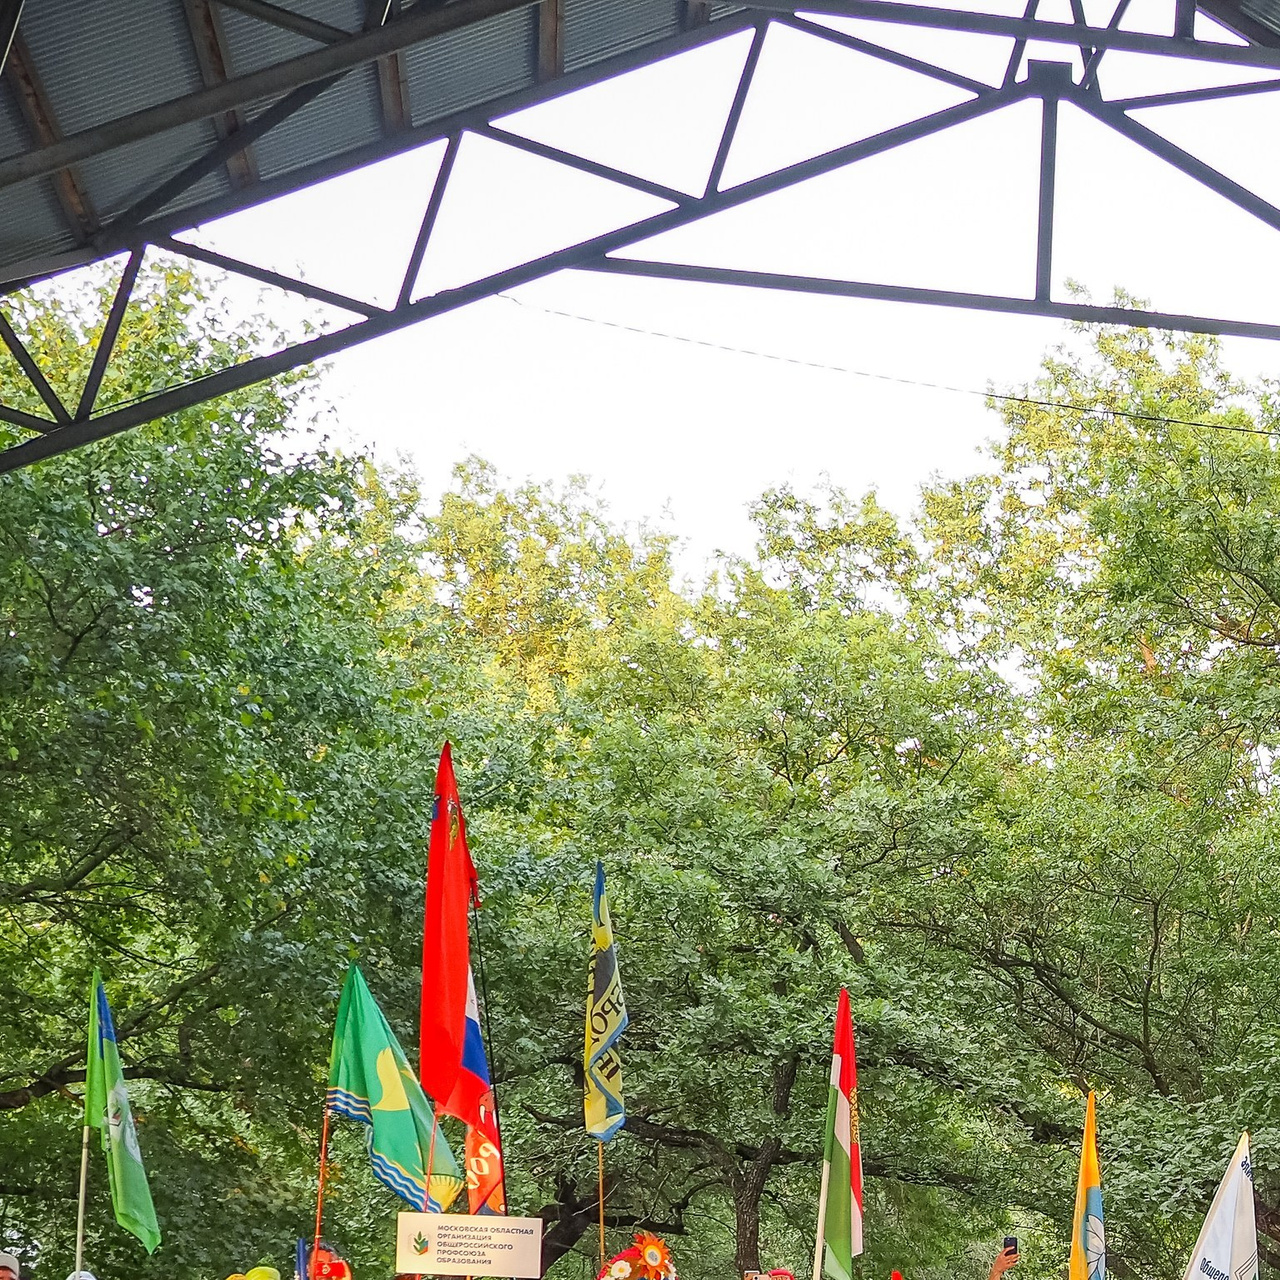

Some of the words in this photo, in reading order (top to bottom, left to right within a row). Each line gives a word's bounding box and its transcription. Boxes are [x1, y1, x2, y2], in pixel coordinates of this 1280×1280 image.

[490, 1227, 534, 1235] ОБЛАСТНАЯ
[437, 1233, 492, 1241] ОРГАНИЗАЦИЯ
[436, 1241, 514, 1250] ОБЩЕРОССИЙСКОГО
[436, 1249, 486, 1257] ПРОФСОЮЗА
[436, 1257, 492, 1265] ОБРАЗОВАНИЯ
